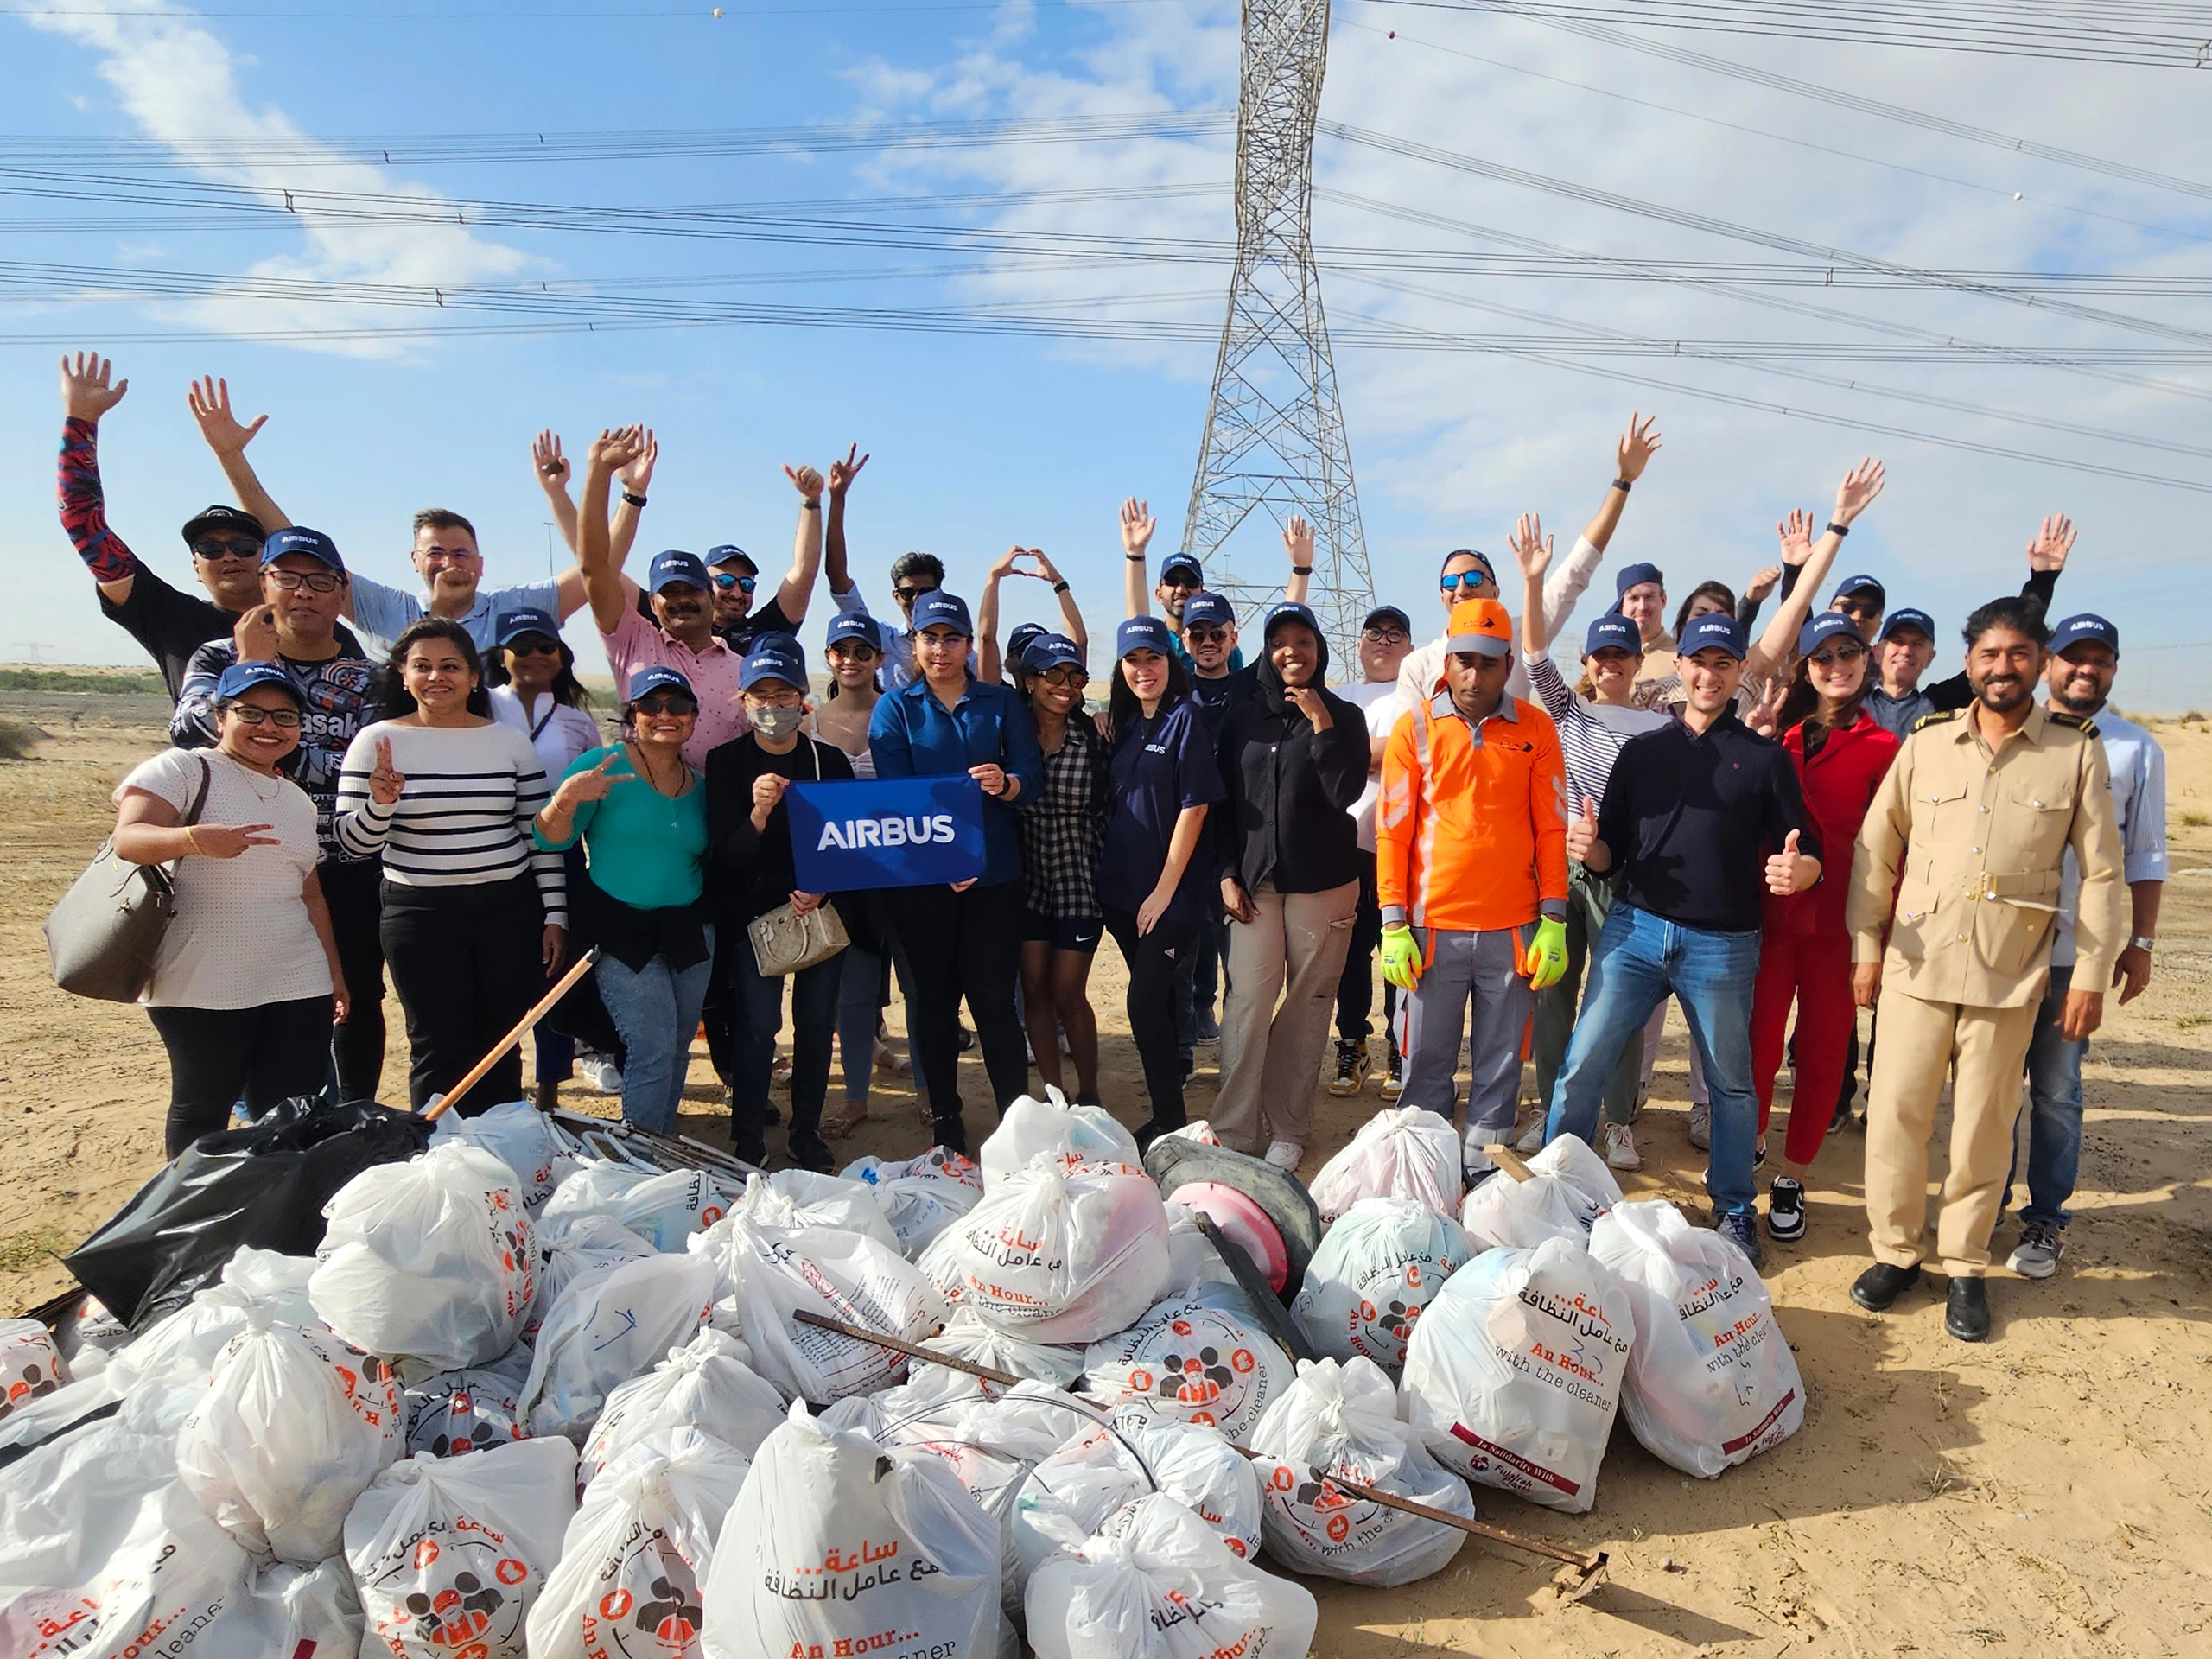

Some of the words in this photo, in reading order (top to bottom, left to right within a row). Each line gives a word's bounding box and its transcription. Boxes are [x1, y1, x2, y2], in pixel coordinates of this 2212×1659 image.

[282, 535, 319, 545] AIRBUS
[659, 560, 690, 569] AIRBUS
[929, 601, 958, 612] AIRBUS
[1191, 601, 1215, 609] AIRBUS
[508, 613, 539, 625] AIRBUS
[837, 620, 866, 630] AIRBUS
[1813, 618, 1844, 632] AIRBUS
[2070, 620, 2105, 632] AIRBUS
[1126, 625, 1154, 634] AIRBUS
[1699, 625, 1732, 635] AIRBUS
[1048, 643, 1076, 653] AIRBUS
[245, 667, 287, 678] AIRBUS
[752, 658, 784, 669] AIRBUS
[647, 673, 680, 683] AIRBUS
[817, 814, 956, 851] AIRBUS
[997, 1249, 1042, 1268] عامل
[989, 1284, 1049, 1306] Hour...
[1517, 1286, 1580, 1328] النظافة
[1350, 1308, 1360, 1332] An
[1580, 1318, 1615, 1346] عامل
[1713, 1331, 1735, 1348] An
[1529, 1341, 1554, 1363] An
[1614, 1336, 1629, 1354] مع
[1495, 1344, 1531, 1374] with
[1536, 1365, 1564, 1389] the
[1567, 1382, 1613, 1412] cleaner
[1477, 1439, 1488, 1448] In
[1487, 1441, 1535, 1475] Solidarity
[1534, 1465, 1555, 1483] With
[1357, 1524, 1382, 1546] the
[795, 1539, 899, 1576] ساعة...
[909, 1559, 940, 1581] مع
[765, 1568, 837, 1601] النظافة
[843, 1564, 902, 1601] عامل
[583, 1614, 598, 1648] An
[790, 1641, 825, 1659] An
[832, 1629, 920, 1658] Hour...
